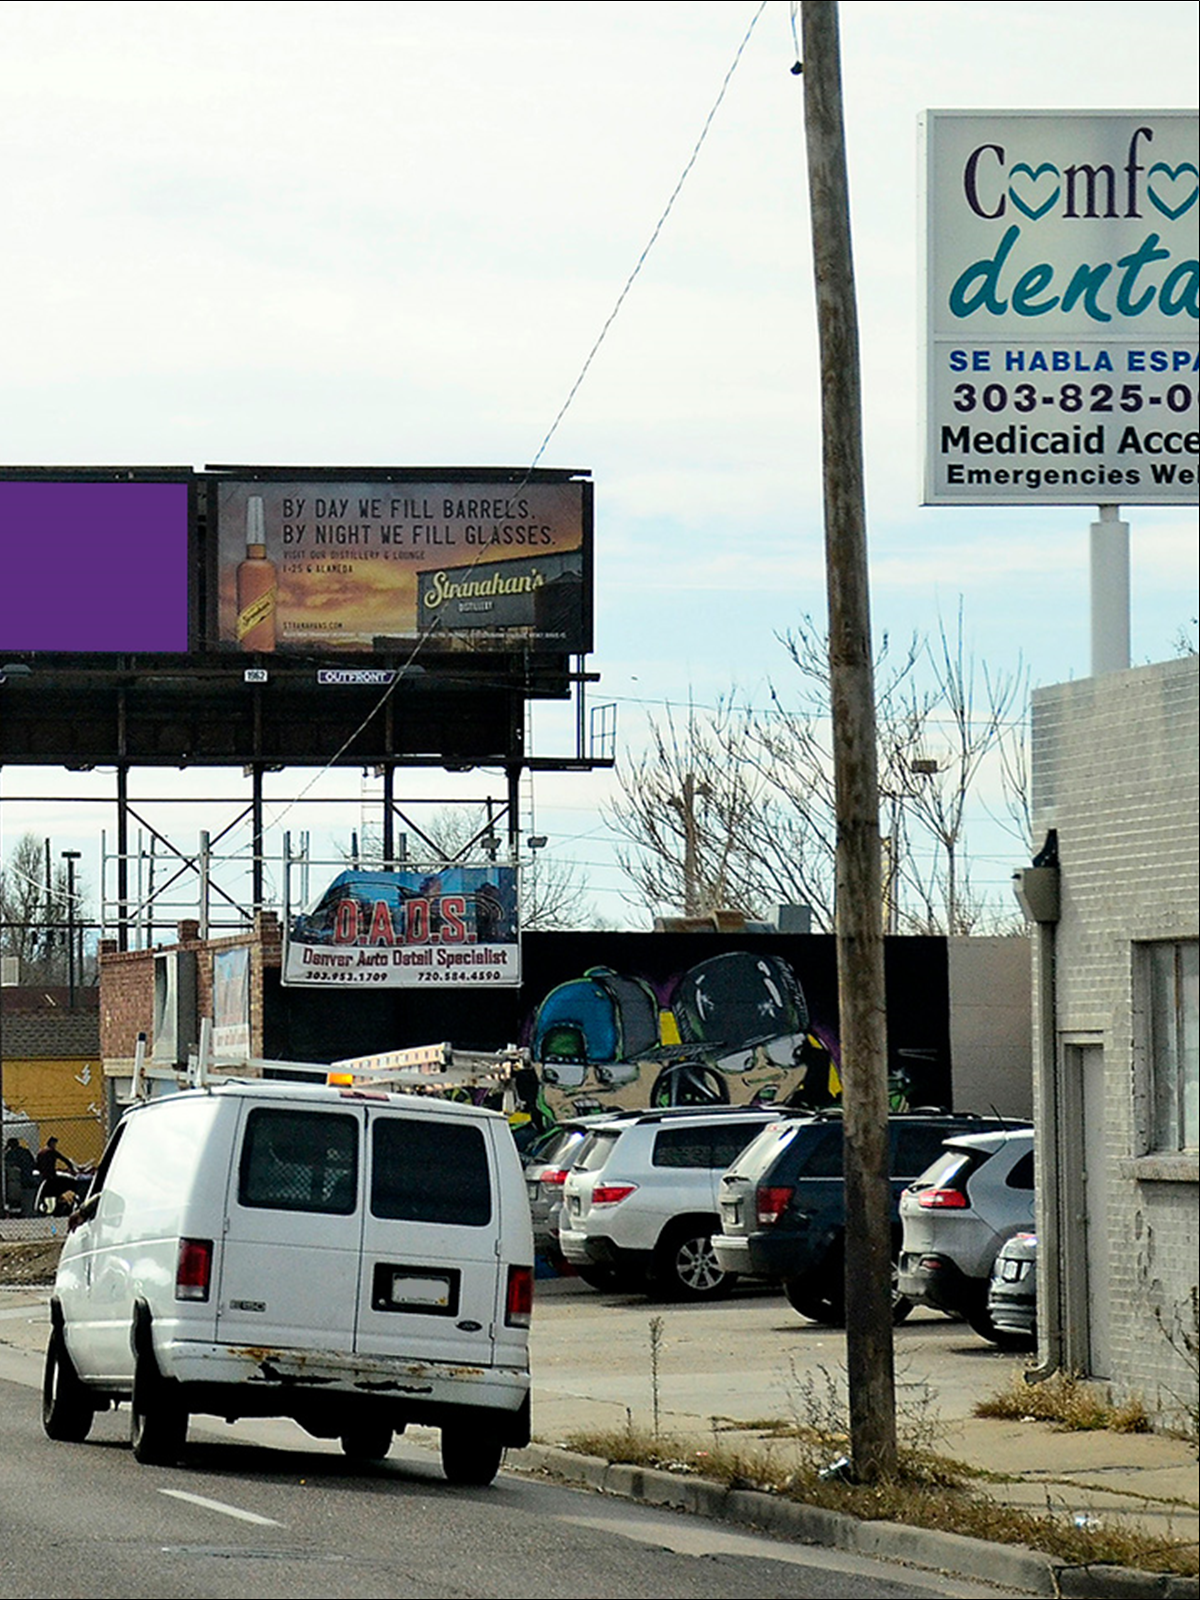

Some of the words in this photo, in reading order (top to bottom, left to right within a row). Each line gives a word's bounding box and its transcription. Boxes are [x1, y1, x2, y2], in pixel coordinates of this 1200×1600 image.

[949, 350, 991, 372] SE
[1005, 350, 1114, 372] HABLA
[953, 383, 1198, 413] 303-825-0
[941, 425, 1105, 454] Medicaid
[947, 464, 1141, 489] Emergencies
[1150, 464, 1198, 484] We
[283, 499, 305, 519] BY
[315, 499, 348, 519] DAY
[359, 499, 381, 519] WE
[390, 499, 434, 519] FILL
[443, 499, 536, 519] BARRELS.
[283, 525, 305, 545] BY
[315, 525, 371, 545] NIGHT
[381, 525, 404, 545] WE
[413, 525, 456, 545] FILL
[465, 525, 556, 545] GLASSES.
[284, 550, 305, 559] VISIT
[310, 550, 326, 559] OUR
[330, 550, 379, 560] DISTILLERY
[393, 550, 426, 560] LOUNGE
[316, 564, 353, 573] ALAMEDA
[424, 568, 544, 608] Stranahan's
[324, 671, 387, 682] OUTFRONT
[303, 948, 353, 967] Denver
[356, 951, 388, 967] Auto
[393, 949, 433, 966] Detail
[437, 948, 508, 968] Specialist
